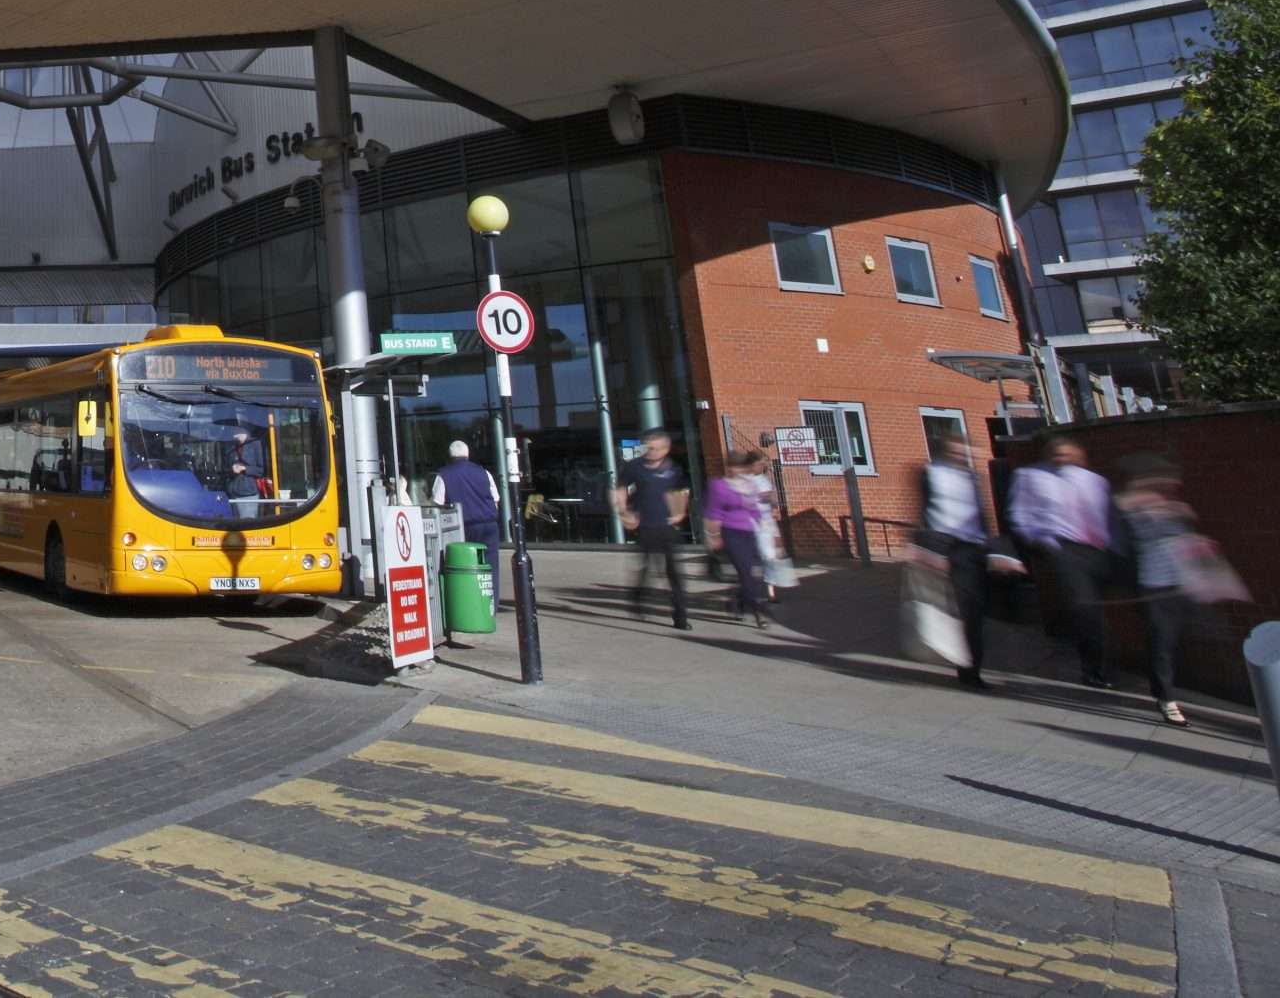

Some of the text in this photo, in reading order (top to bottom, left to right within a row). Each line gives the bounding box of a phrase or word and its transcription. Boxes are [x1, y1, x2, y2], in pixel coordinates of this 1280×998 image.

[221, 152, 255, 184] Bus
[265, 112, 364, 163] Statn
[488, 308, 522, 335] 10
[384, 336, 452, 349] BUS STAND E
[145, 355, 176, 379] 210
[196, 355, 224, 368] North
[223, 368, 260, 379] Buxton
[238, 578, 256, 588] NXS
[400, 594, 418, 607] DO NOT
